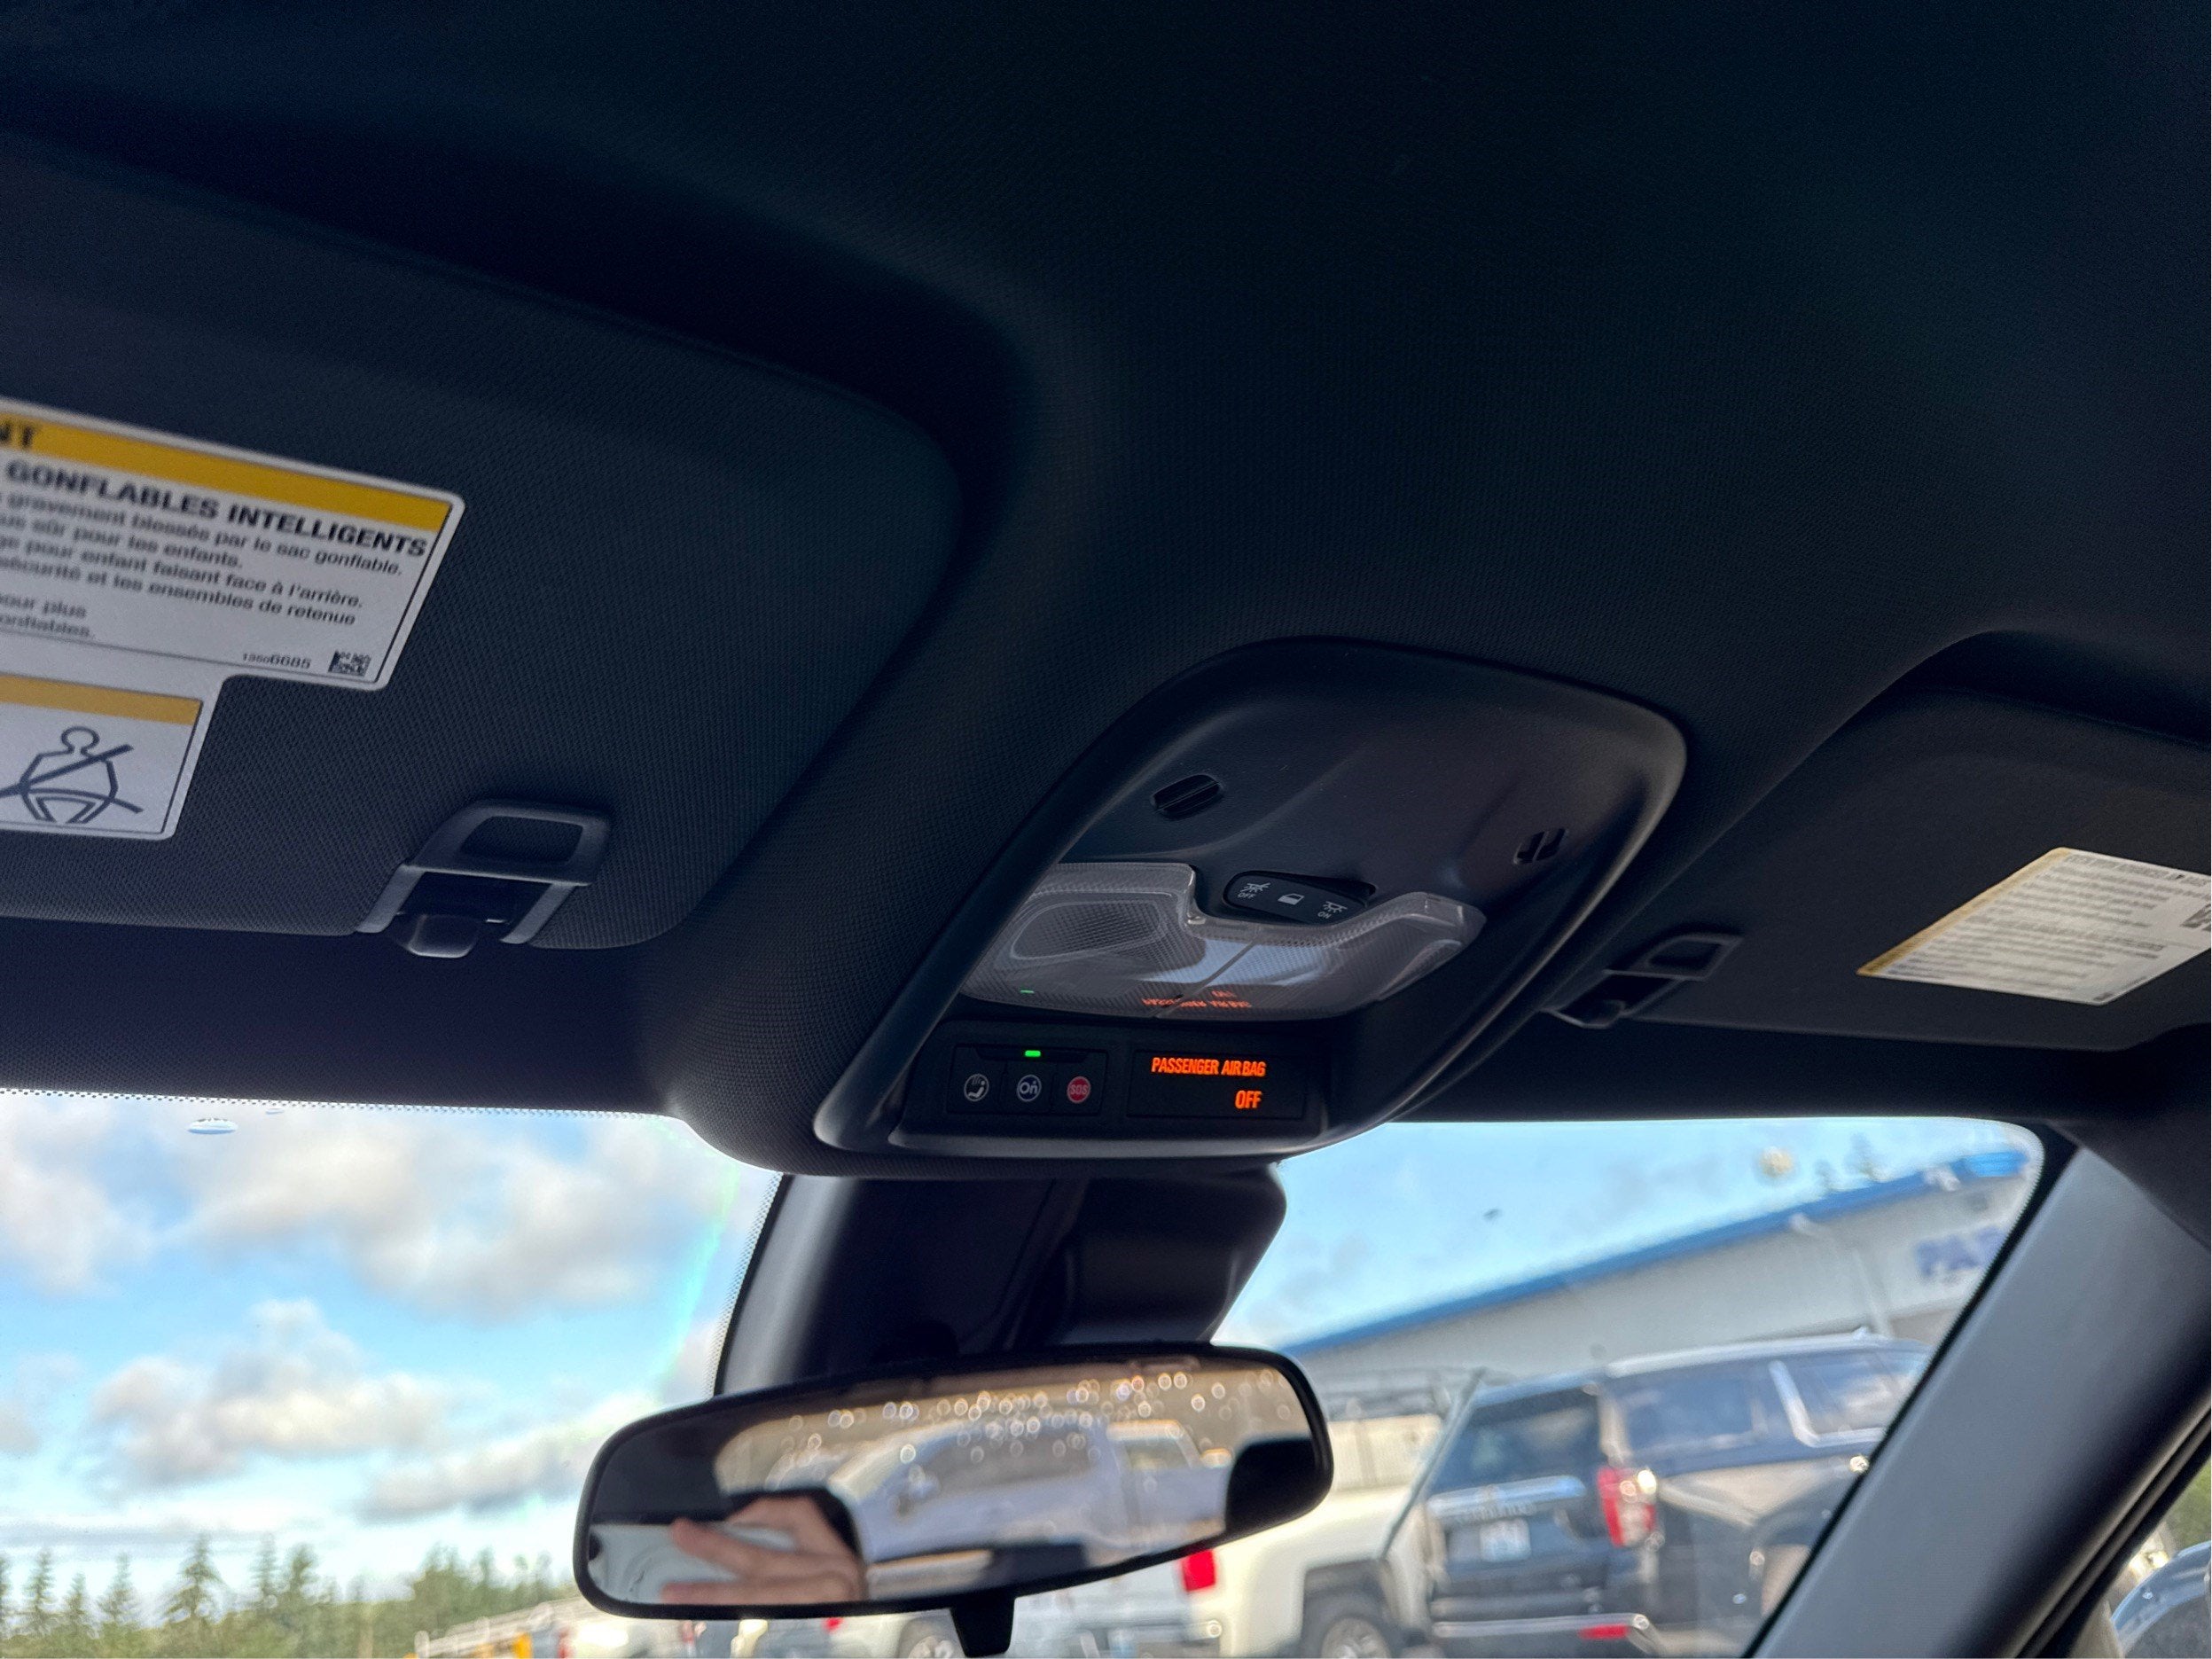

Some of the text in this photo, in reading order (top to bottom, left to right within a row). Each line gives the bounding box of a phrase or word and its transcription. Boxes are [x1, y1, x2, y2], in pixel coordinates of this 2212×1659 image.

[5, 459, 427, 557] GONFLABLES INTELLIGENTS
[7, 491, 127, 527] gravement
[131, 512, 210, 542] blessés
[214, 530, 247, 548] par
[254, 536, 272, 553] le
[276, 543, 310, 559] sac
[25, 540, 74, 559] pour
[81, 551, 147, 573] enfant
[153, 560, 220, 584] faisant
[226, 575, 267, 592] face
[271, 581, 284, 596] à
[73, 528, 121, 547] pour
[128, 536, 159, 554] les
[163, 544, 243, 568] enfants.
[43, 600, 88, 619] plus
[86, 572, 107, 586] et
[113, 575, 143, 592] les
[148, 582, 254, 609] ensembles
[259, 599, 283, 614] de
[287, 605, 356, 626] retenue
[1151, 1057, 1219, 1076] PASSENGER
[1070, 1084, 1088, 1095] SOS
[1234, 1090, 1262, 1109] OFF
